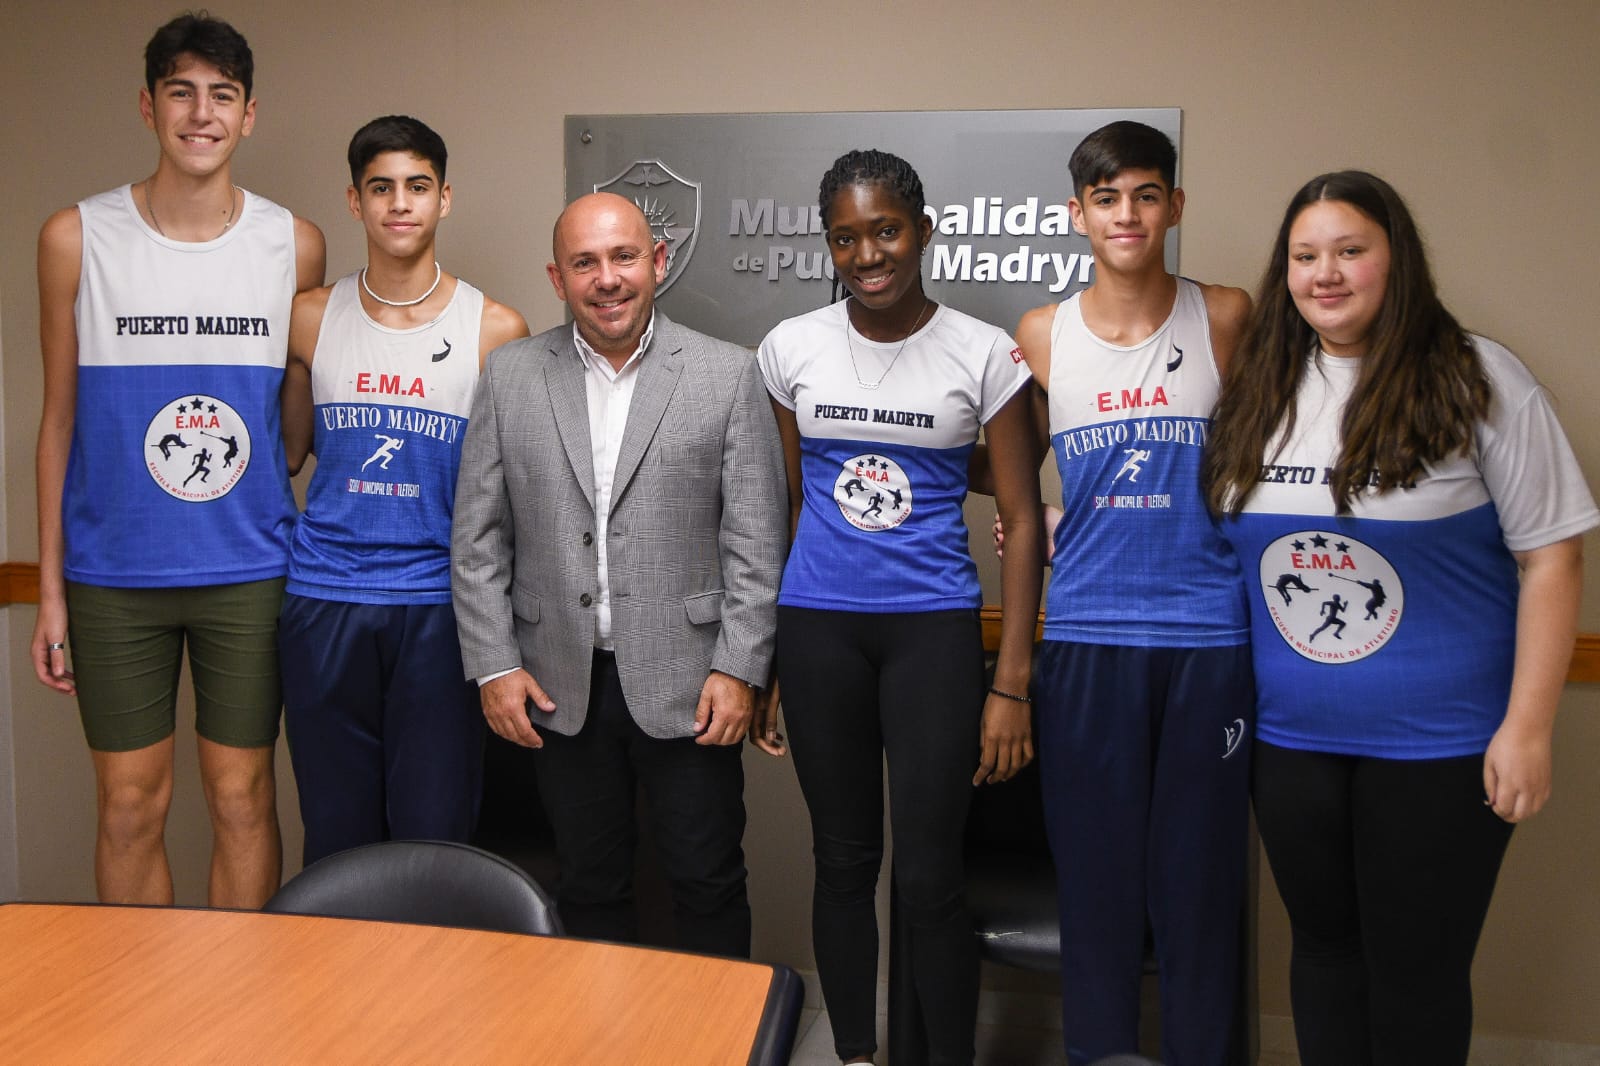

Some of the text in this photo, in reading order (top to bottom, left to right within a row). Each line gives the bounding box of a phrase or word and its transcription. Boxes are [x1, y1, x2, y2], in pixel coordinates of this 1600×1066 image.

[729, 196, 1089, 236] Mualida
[733, 251, 764, 272] de
[116, 316, 270, 336] PUERTO MADRYN
[356, 372, 426, 398] E.M.A
[1097, 386, 1168, 412] E.M.A
[175, 415, 220, 429] E.M.A
[387, 409, 463, 444] MADRYN
[814, 404, 935, 429] PUERTO MADRYN
[1062, 421, 1209, 460] PUERTO MADRYN
[149, 462, 170, 488] ESCUELA
[171, 486, 210, 498] MUNICIPAL
[221, 459, 246, 491] ATLETISMO
[855, 466, 889, 482] E.M.A
[1257, 465, 1316, 484] ERTO
[1290, 553, 1357, 571] E.M.A
[1270, 606, 1399, 659] ESCUELA MUNICIPAL DE ATLETISMO
